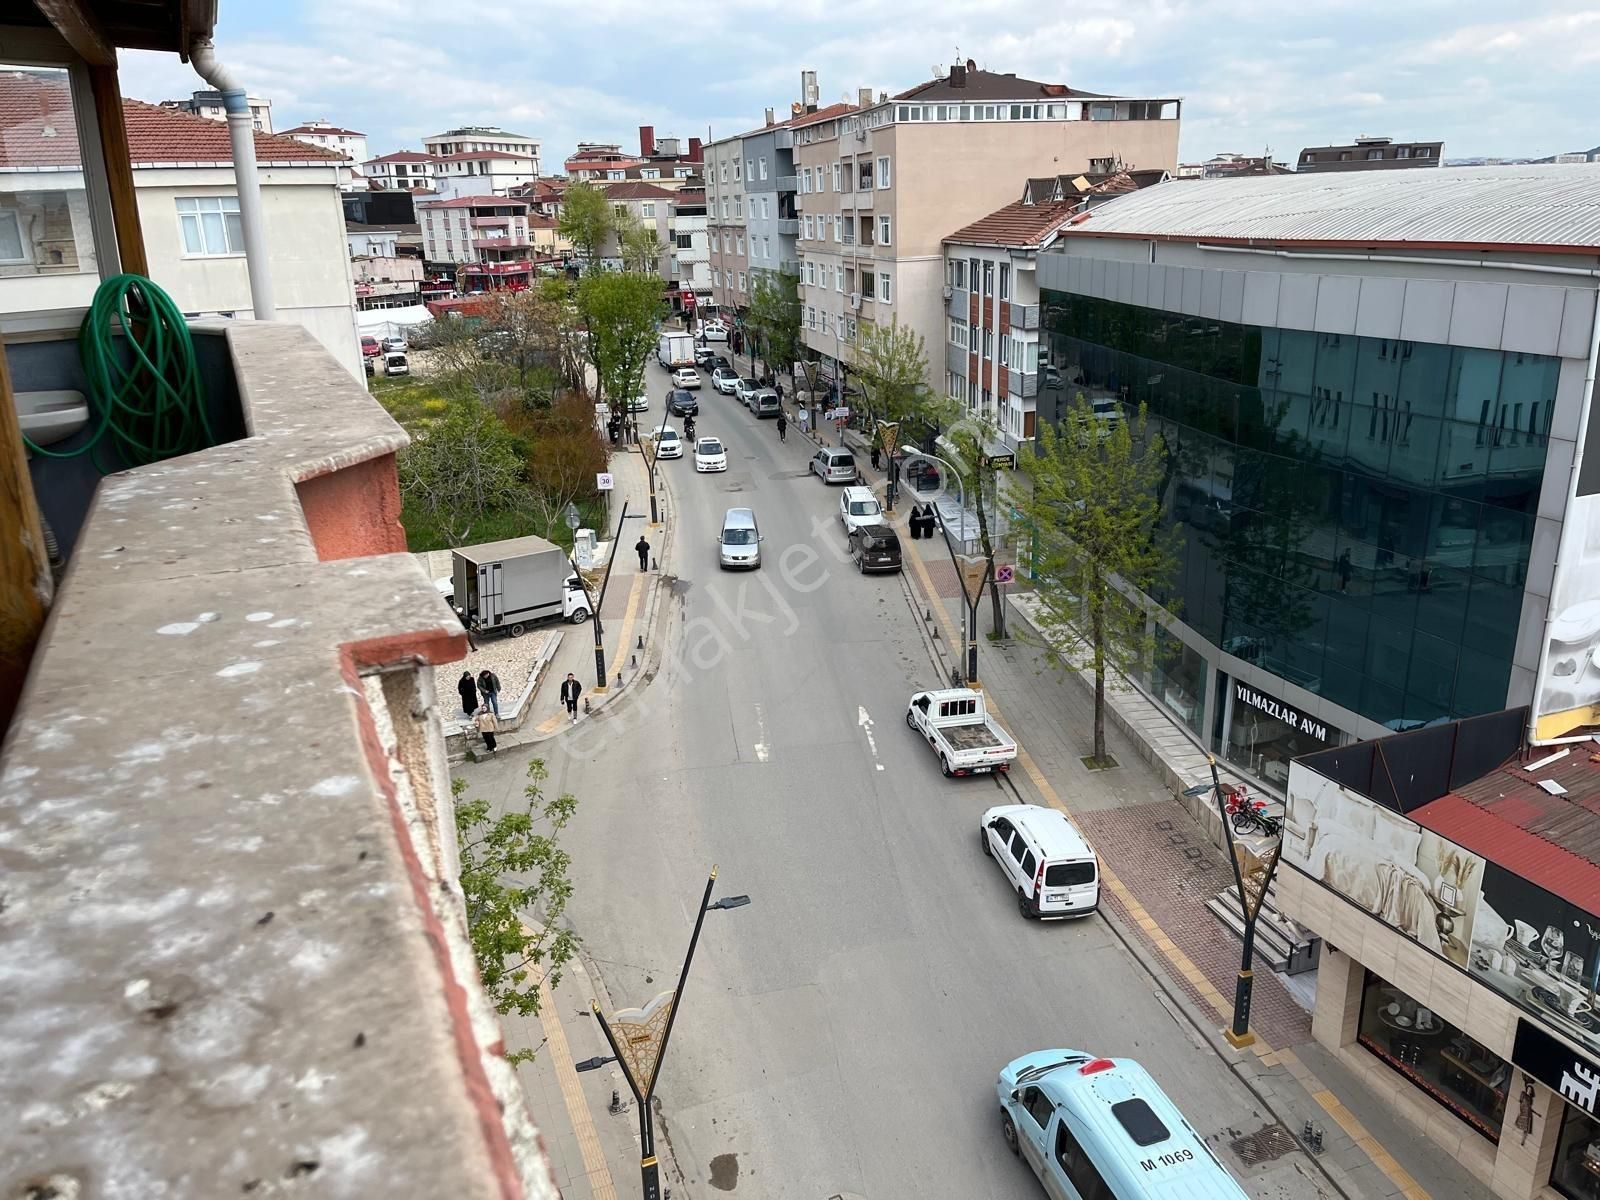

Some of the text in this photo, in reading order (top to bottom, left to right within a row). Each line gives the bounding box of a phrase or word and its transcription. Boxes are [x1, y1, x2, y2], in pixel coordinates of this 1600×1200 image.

[1236, 684, 1326, 741] YILMAZLAR AVM
[1140, 1149, 1193, 1171] M 1069
